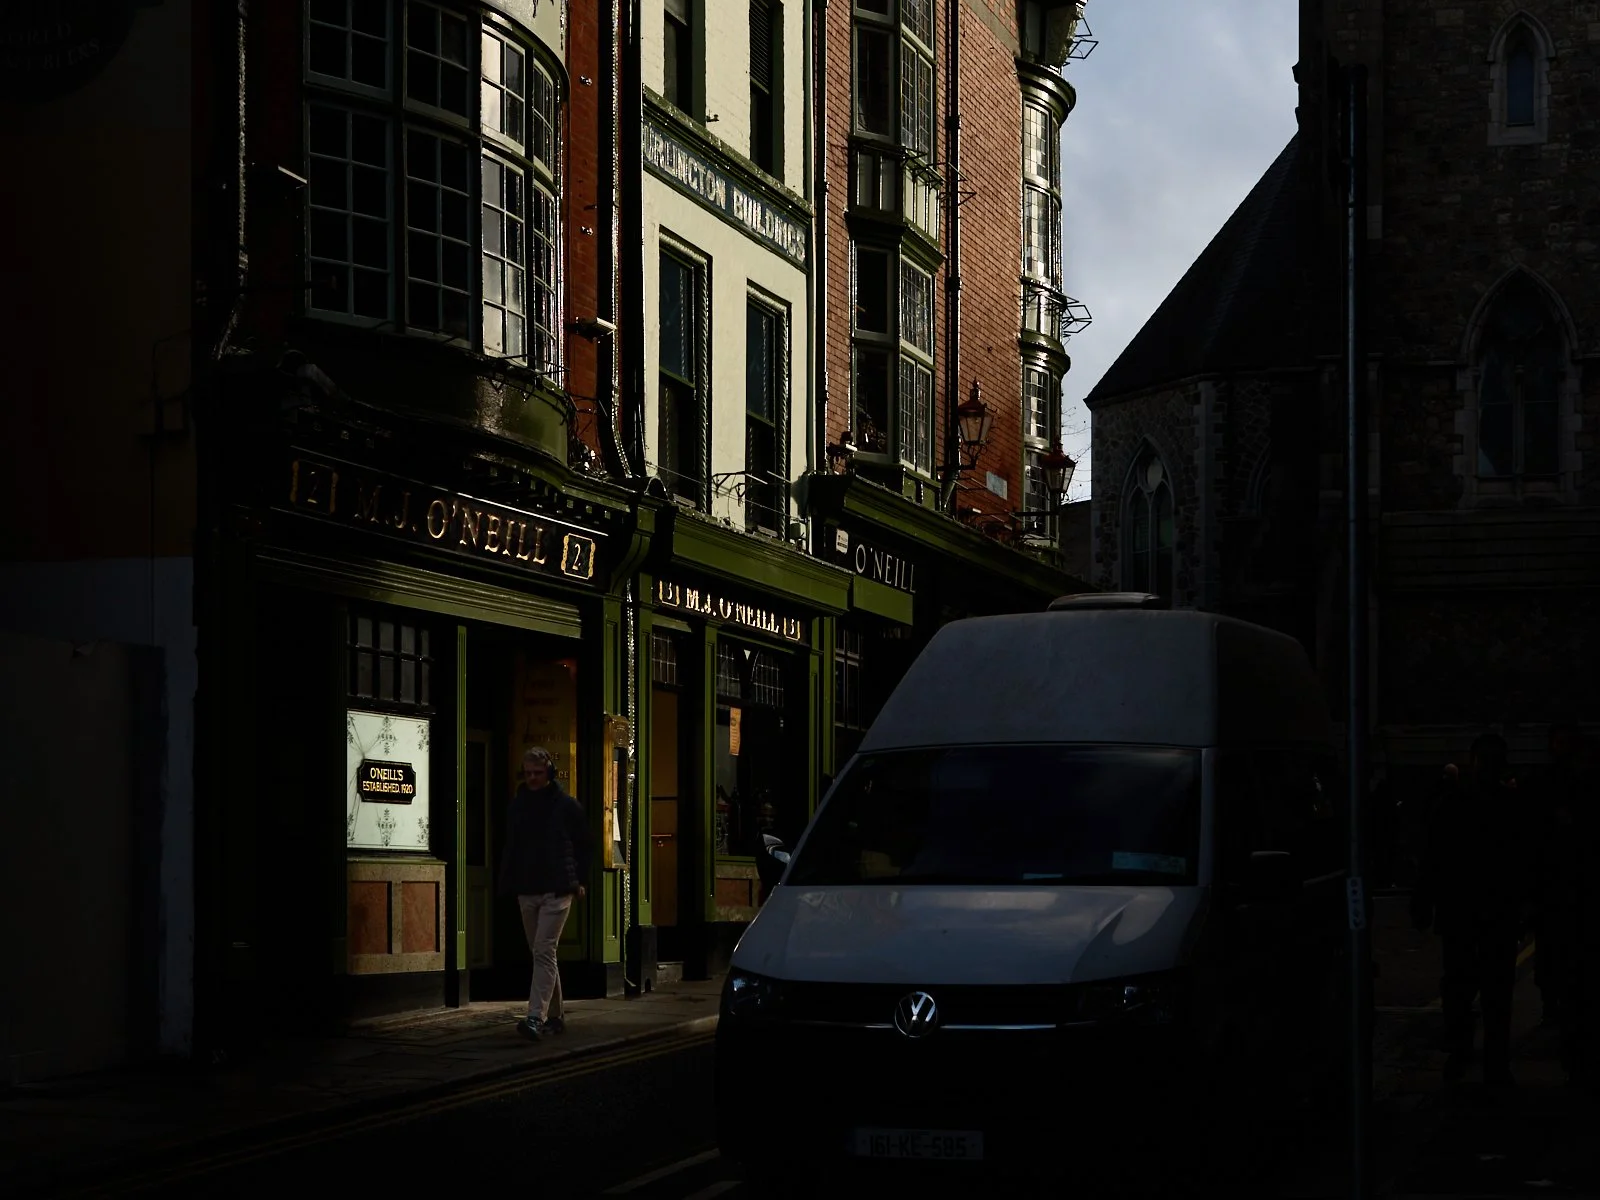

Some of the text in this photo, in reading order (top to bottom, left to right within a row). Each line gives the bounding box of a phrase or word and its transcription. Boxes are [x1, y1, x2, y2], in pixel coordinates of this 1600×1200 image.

[642, 122, 807, 263] URLINGTON BUILDINGS
[352, 477, 419, 534] M.J.
[426, 498, 550, 565] O'NEILL
[571, 543, 583, 571] 2
[855, 543, 917, 594] O'NEILL
[685, 587, 717, 617] M.J.
[718, 597, 780, 634] O'NEILL
